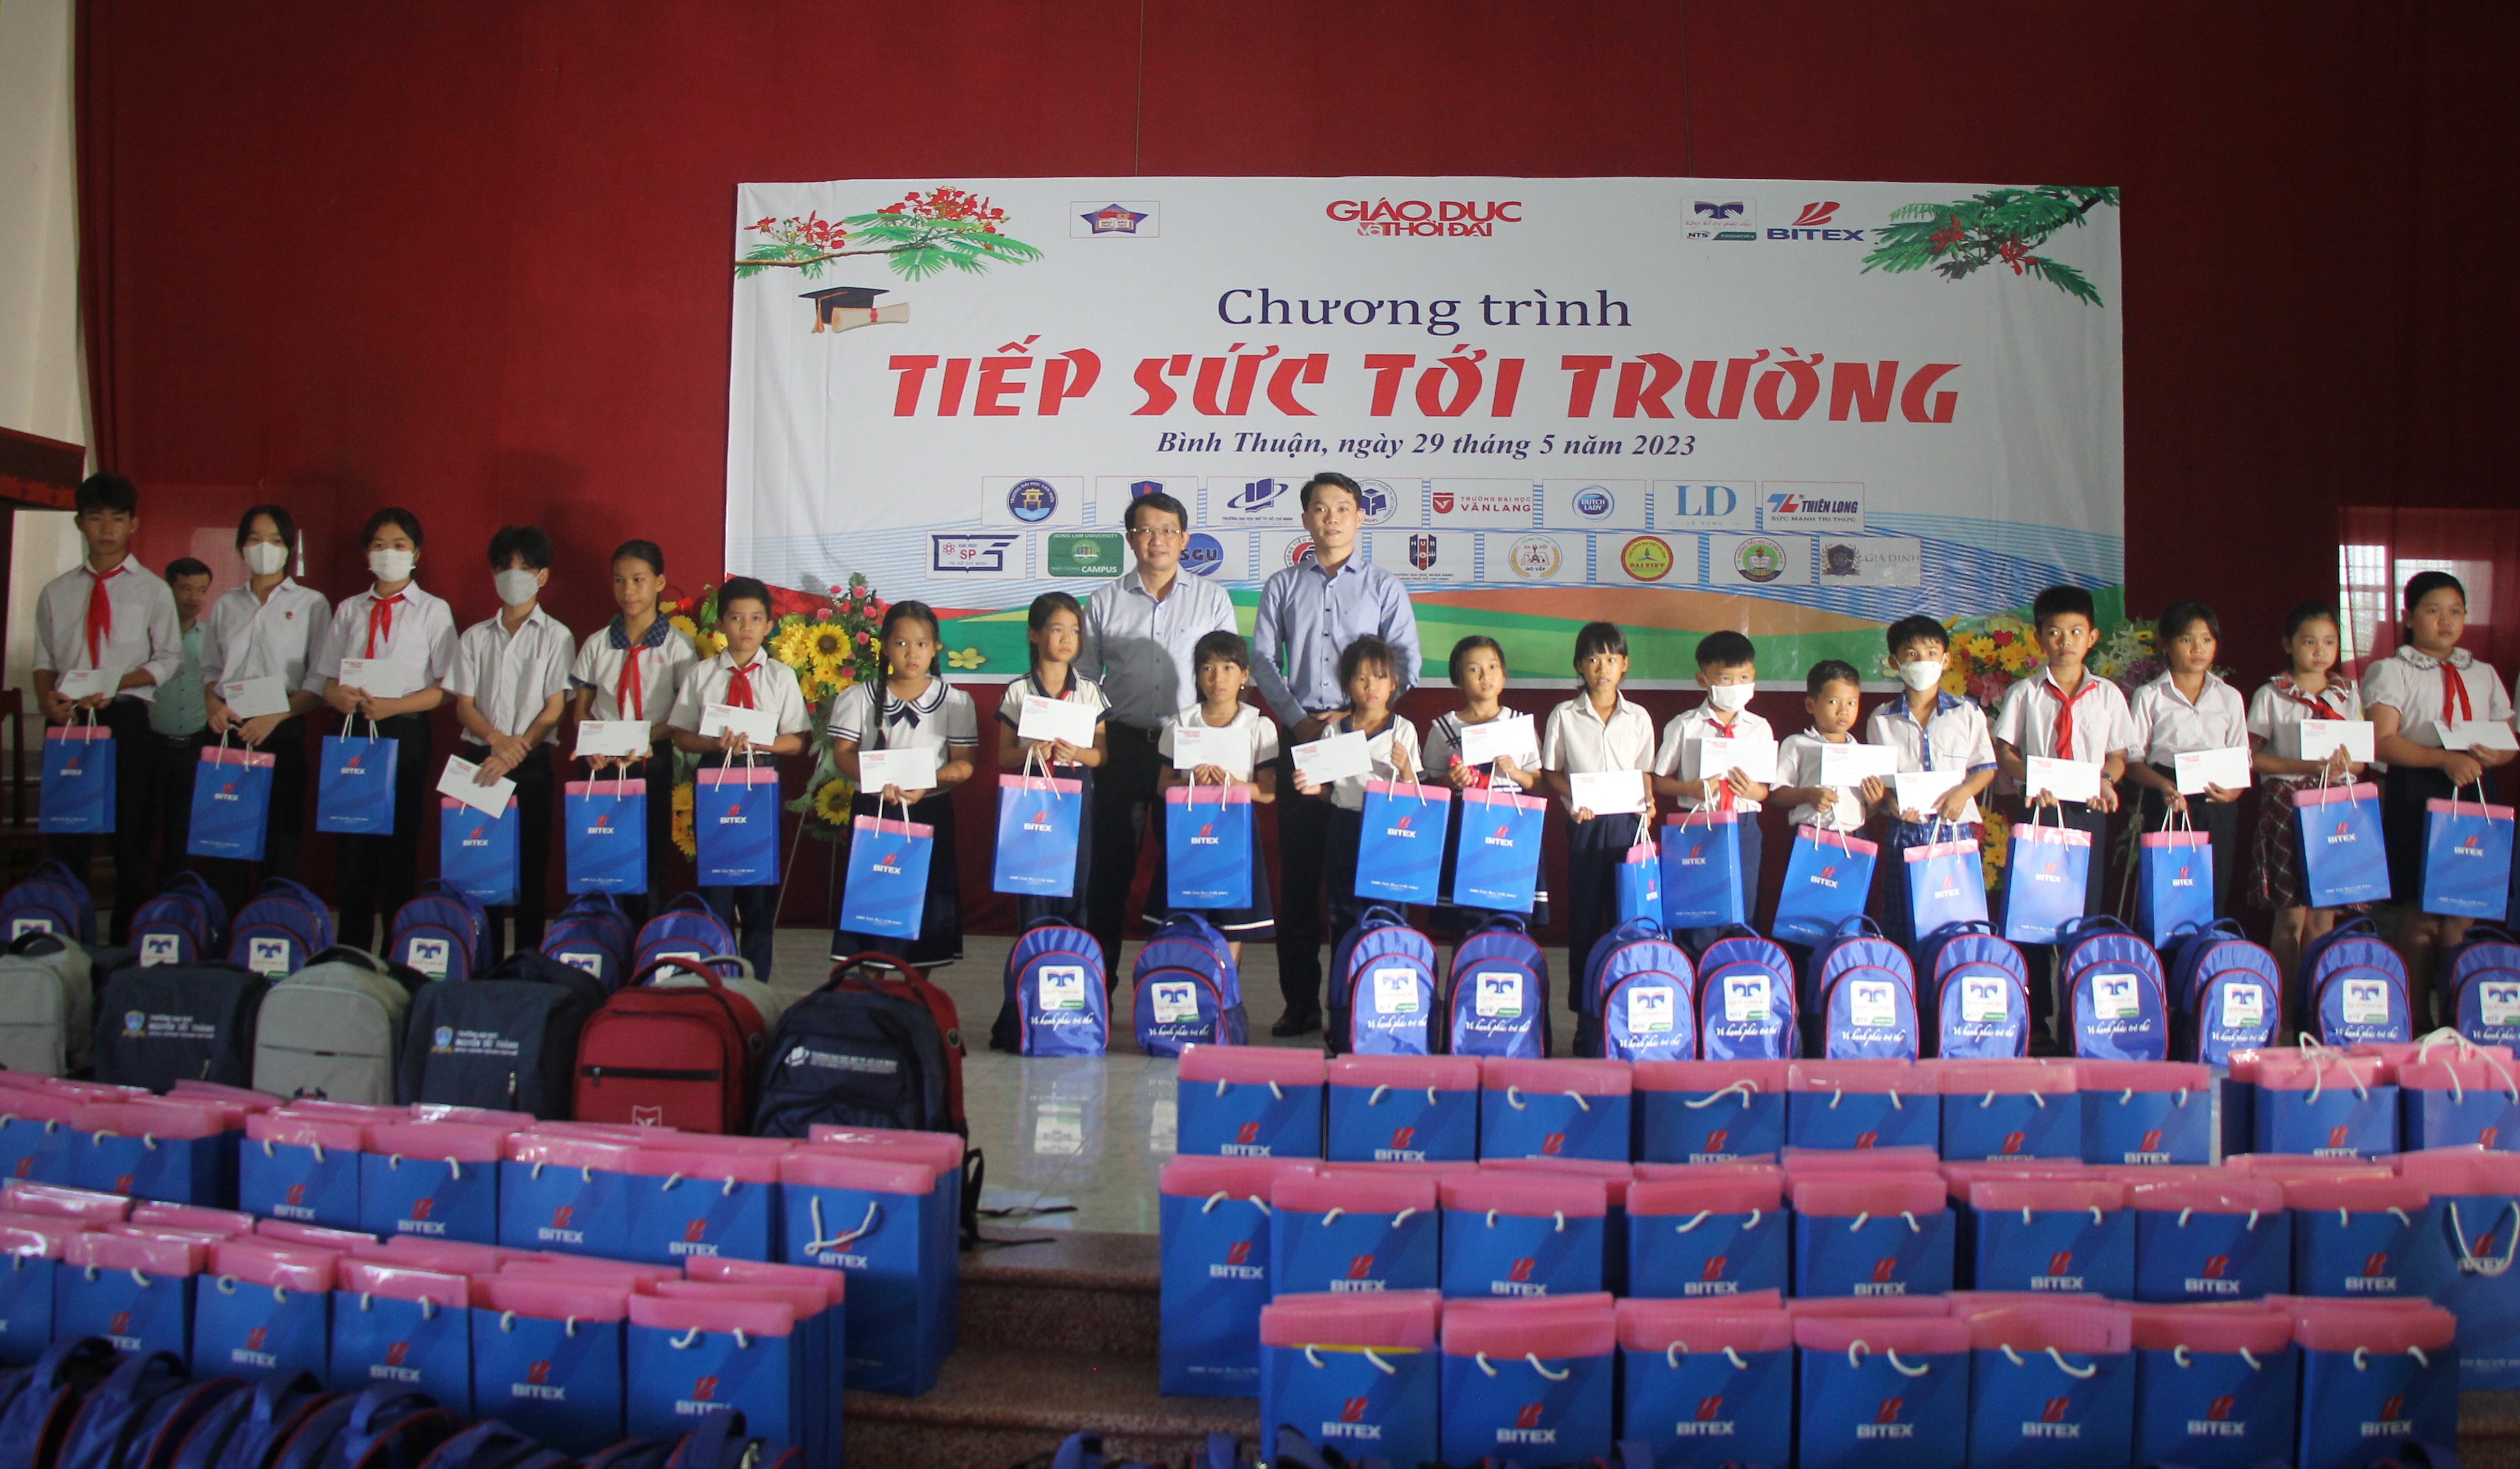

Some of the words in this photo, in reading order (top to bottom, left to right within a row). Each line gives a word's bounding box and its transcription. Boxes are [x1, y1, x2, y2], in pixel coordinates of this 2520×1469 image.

[1326, 197, 1432, 223] GIÁO
[1767, 228, 1865, 241] BITEX
[1218, 289, 1461, 336] Chương
[1479, 289, 1631, 327] trình
[887, 335, 1101, 417] TIẾP
[1130, 342, 1329, 417] SỨC
[1364, 343, 1525, 417] TỚI
[1559, 346, 1962, 424] TRƯỜNG
[1156, 431, 1222, 453] Bình
[1233, 432, 1328, 458] Thuận,
[1338, 432, 1406, 459] ngày
[1411, 432, 1445, 455] 29
[1451, 432, 1529, 460] tháng
[1539, 433, 1553, 455] 5
[1563, 434, 1622, 456] năm
[1630, 434, 1697, 457] 2023
[1675, 486, 1737, 515] LD
[1802, 498, 1830, 513] THIÊN
[1832, 501, 1858, 513] LONG
[960, 550, 976, 559] SP
[1179, 549, 1217, 561] SGU
[1024, 823, 1051, 832] BITEX
[1387, 827, 1416, 838] BITEX
[1485, 836, 1513, 847] BITEX
[2328, 834, 2355, 843] BITEX
[2454, 847, 2483, 856] BITEX
[873, 865, 901, 874] BITEX
[1810, 875, 1838, 888] BITEX
[2036, 873, 2060, 883] BITEX
[1935, 888, 1960, 898] BITEX
[1221, 1145, 1270, 1157] BITEX
[1374, 1149, 1425, 1162] BITEX
[2314, 1148, 2357, 1158] BITEX
[2125, 1153, 2170, 1163] BITEX
[273, 1205, 315, 1221] BITEX
[398, 1220, 445, 1235] BITEX
[538, 1228, 582, 1243] BITEX
[669, 1242, 718, 1257] BITEX
[819, 1252, 868, 1269] BITEX
[1210, 1265, 1261, 1278] BITEX
[1331, 1280, 1385, 1292] BITEX
[1492, 1281, 1547, 1296] BITEX
[1685, 1282, 1738, 1294] BITEX
[1854, 1283, 1905, 1296] BITEX
[2031, 1277, 2082, 1289] BITEX
[2185, 1279, 2239, 1292] BITEX
[2346, 1277, 2396, 1290] BITEX
[232, 1349, 275, 1367] BITEX
[370, 1366, 419, 1381] BITEX
[512, 1384, 565, 1399] BITEX
[1322, 1423, 1380, 1438] BITEX
[1677, 1421, 1733, 1435] BITEX
[1857, 1424, 1912, 1438] BITEX
[2023, 1423, 2079, 1437] BITEX
[2188, 1421, 2244, 1435] BITEX
[2361, 1421, 2411, 1435] BITEX
[1497, 1429, 1555, 1443] BITEX
